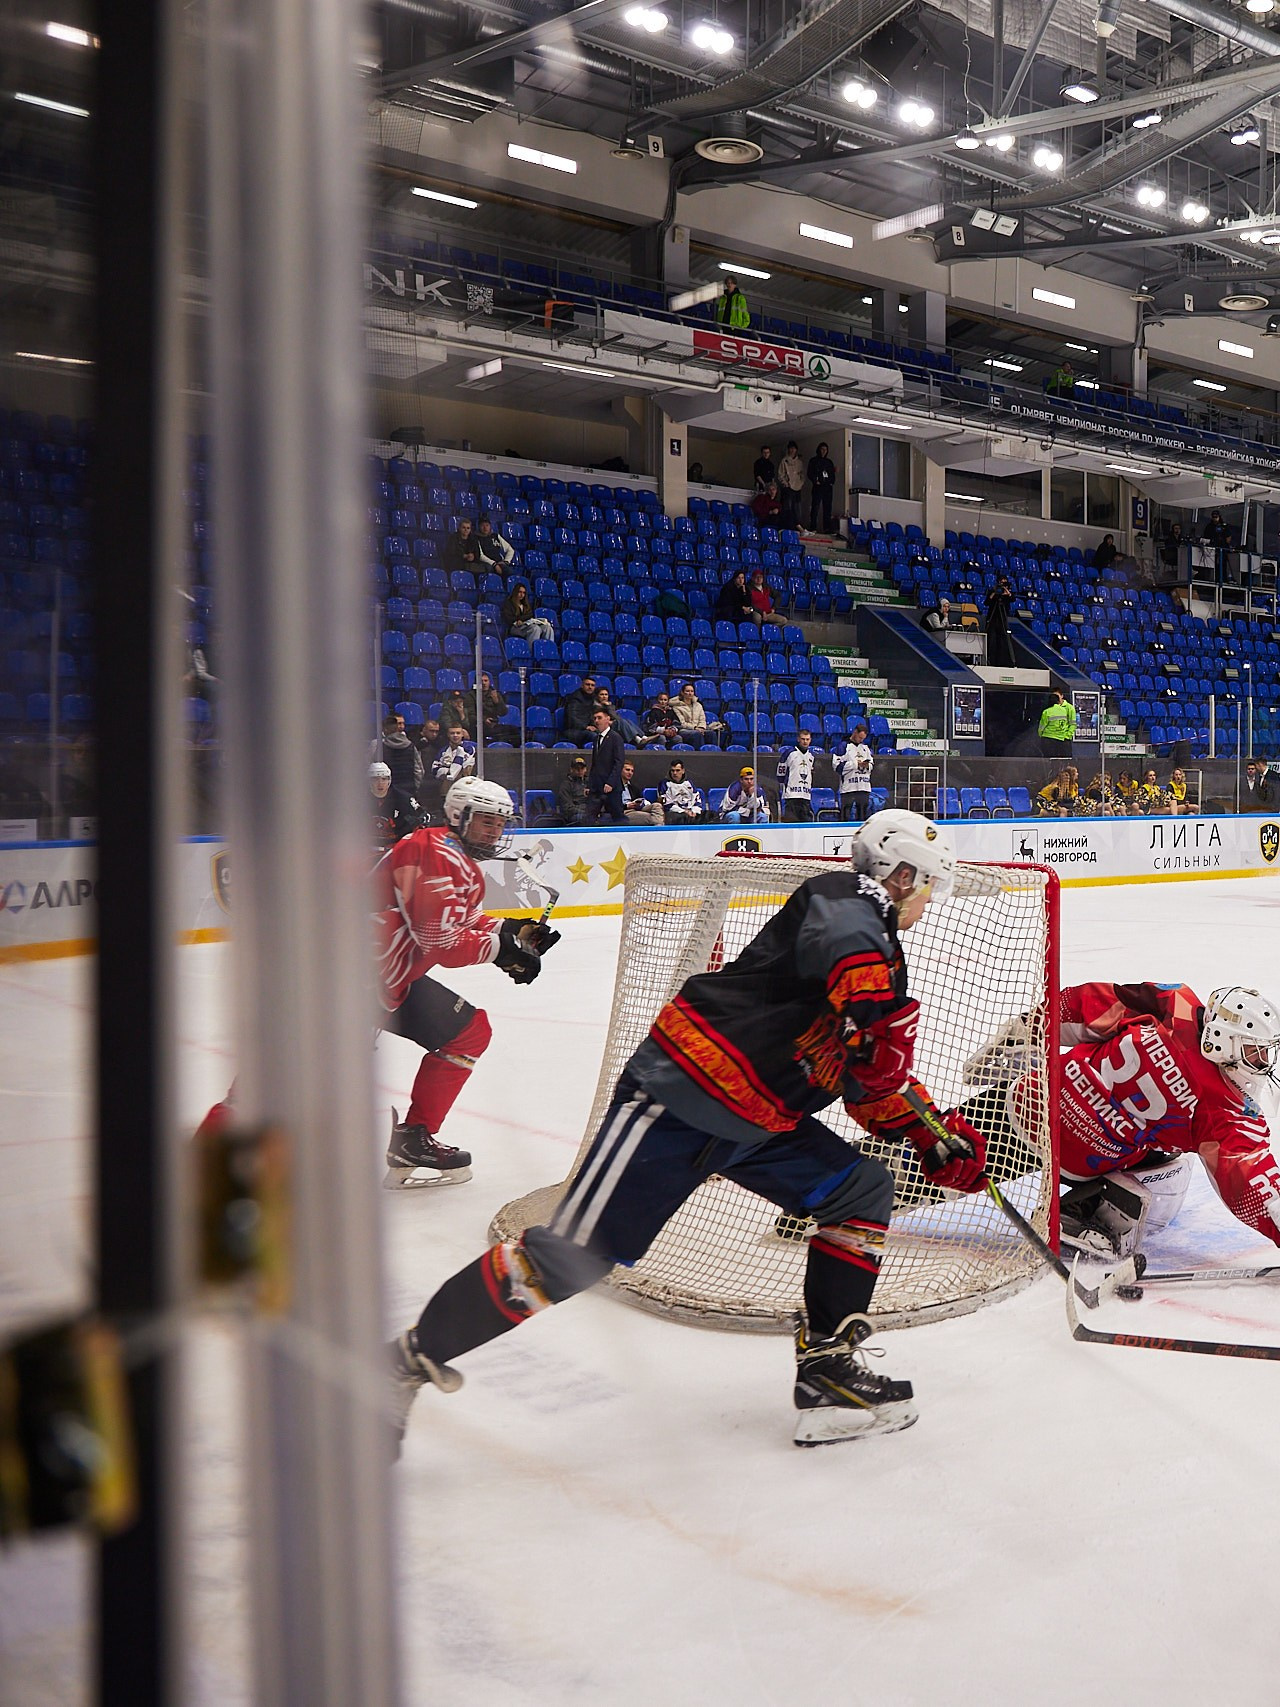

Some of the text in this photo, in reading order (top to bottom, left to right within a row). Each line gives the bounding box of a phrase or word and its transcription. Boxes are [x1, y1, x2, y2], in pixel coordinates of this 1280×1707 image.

[720, 340, 803, 372] SPAR
[1010, 404, 1055, 421] OLIMPBET
[1056, 414, 1107, 433] ЧЕМПИОНАТ
[1108, 426, 1140, 440] РОССИИ
[1142, 433, 1153, 443] ПО
[1155, 436, 1185, 449] ХОККЕЮ
[1196, 444, 1254, 463] ВСЕРОССИЙСКАЯ
[672, 441, 679, 452] 1
[1136, 503, 1144, 519] 9
[850, 579, 874, 587] SYNERGETIC
[867, 595, 890, 603] SYNERGETIC
[850, 679, 876, 687] SYNERGETIC
[1044, 835, 1088, 849] НИЖНИЙ
[1149, 823, 1222, 849] ЛИГА
[1043, 849, 1097, 864] НОВГОРОД
[1153, 855, 1221, 870] СИЛЬНЫХ
[1064, 1060, 1134, 1138] ФЕНИКС
[1230, 1079, 1254, 1102] BAUER
[1060, 1087, 1105, 1134] ИВАНОВСКАЯ
[1059, 1114, 1120, 1159] ГПС МЧС РОССИИ
[1141, 1166, 1183, 1184] BAUER
[1192, 1266, 1258, 1281] BAUER
[1113, 1333, 1176, 1351] SOYUZ
